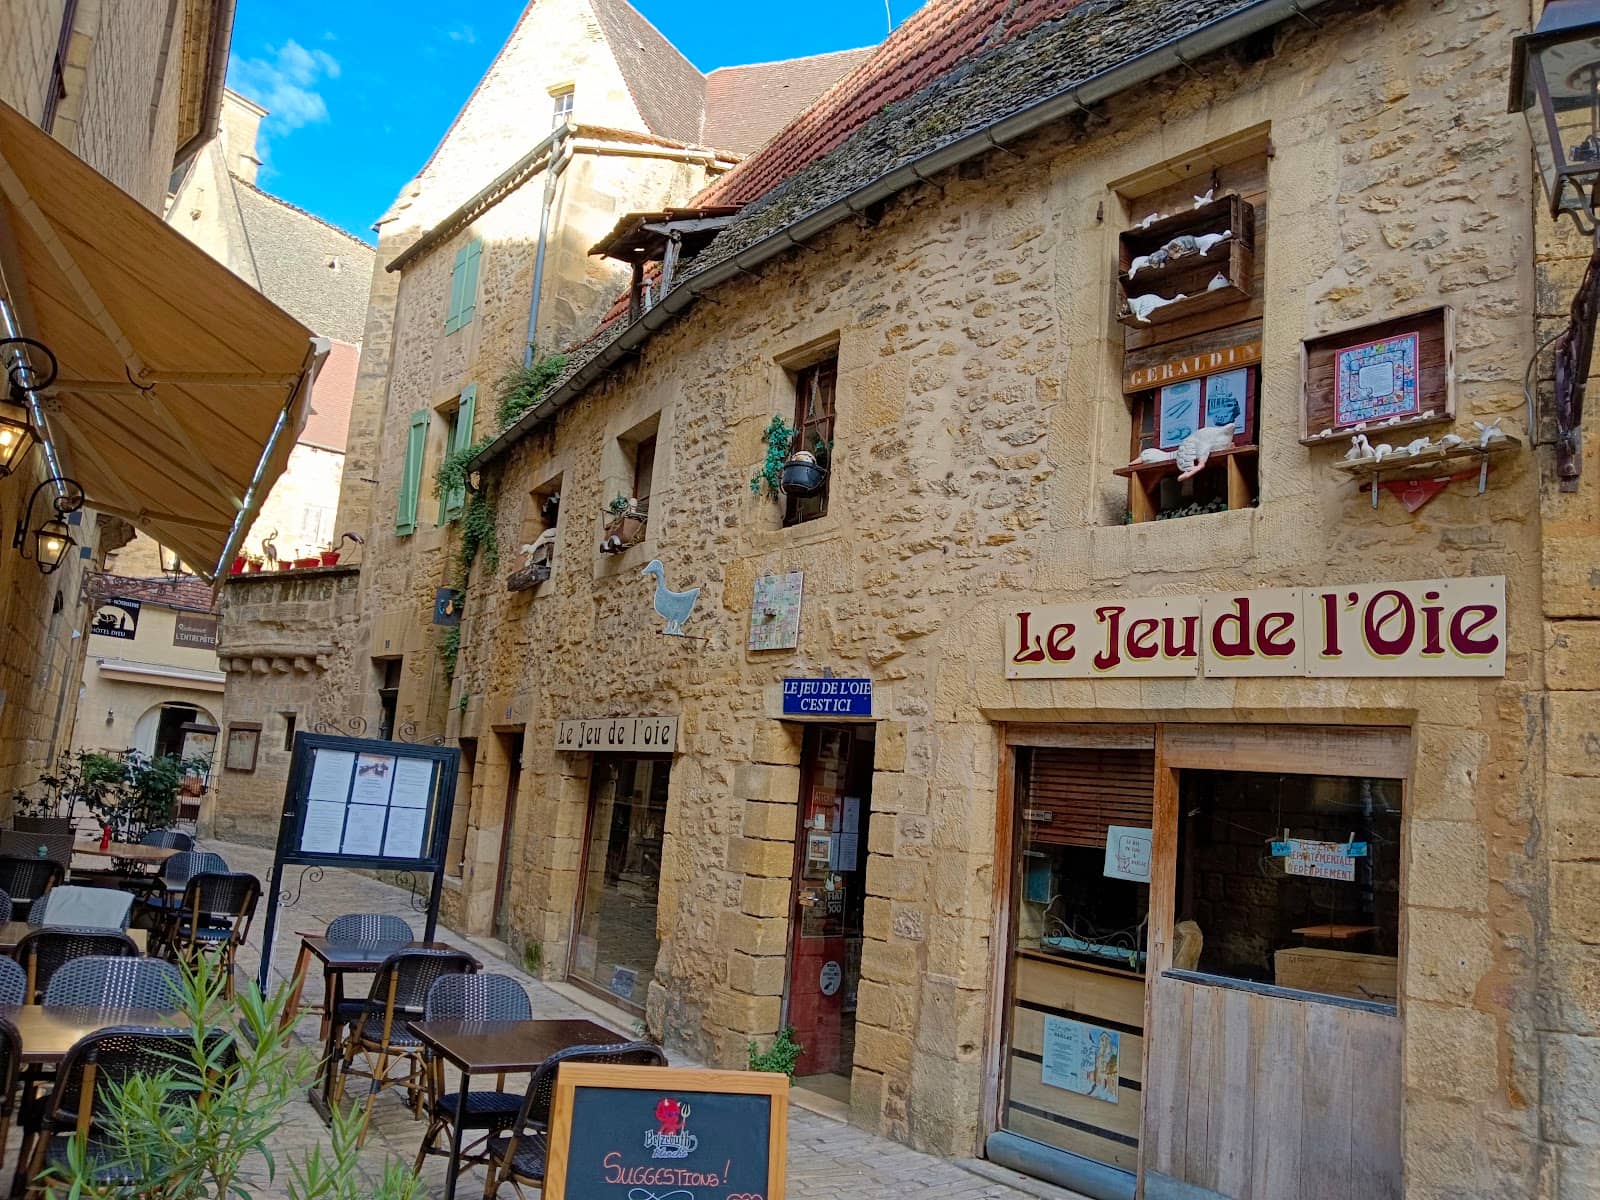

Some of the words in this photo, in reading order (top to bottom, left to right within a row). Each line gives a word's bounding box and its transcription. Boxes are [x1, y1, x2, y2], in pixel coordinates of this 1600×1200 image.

[1013, 611, 1077, 663] Le
[1093, 606, 1200, 671] Jeu
[1211, 597, 1296, 658] de
[1320, 589, 1500, 658] l'Oie
[783, 682, 798, 695] LE
[797, 682, 820, 697] JEU
[821, 682, 838, 695] DE
[839, 682, 871, 695] L'OIE
[800, 698, 832, 711] C'EST
[833, 699, 851, 712] ICI
[558, 721, 573, 745] Le
[608, 720, 625, 745] de
[632, 718, 670, 745] l'oie
